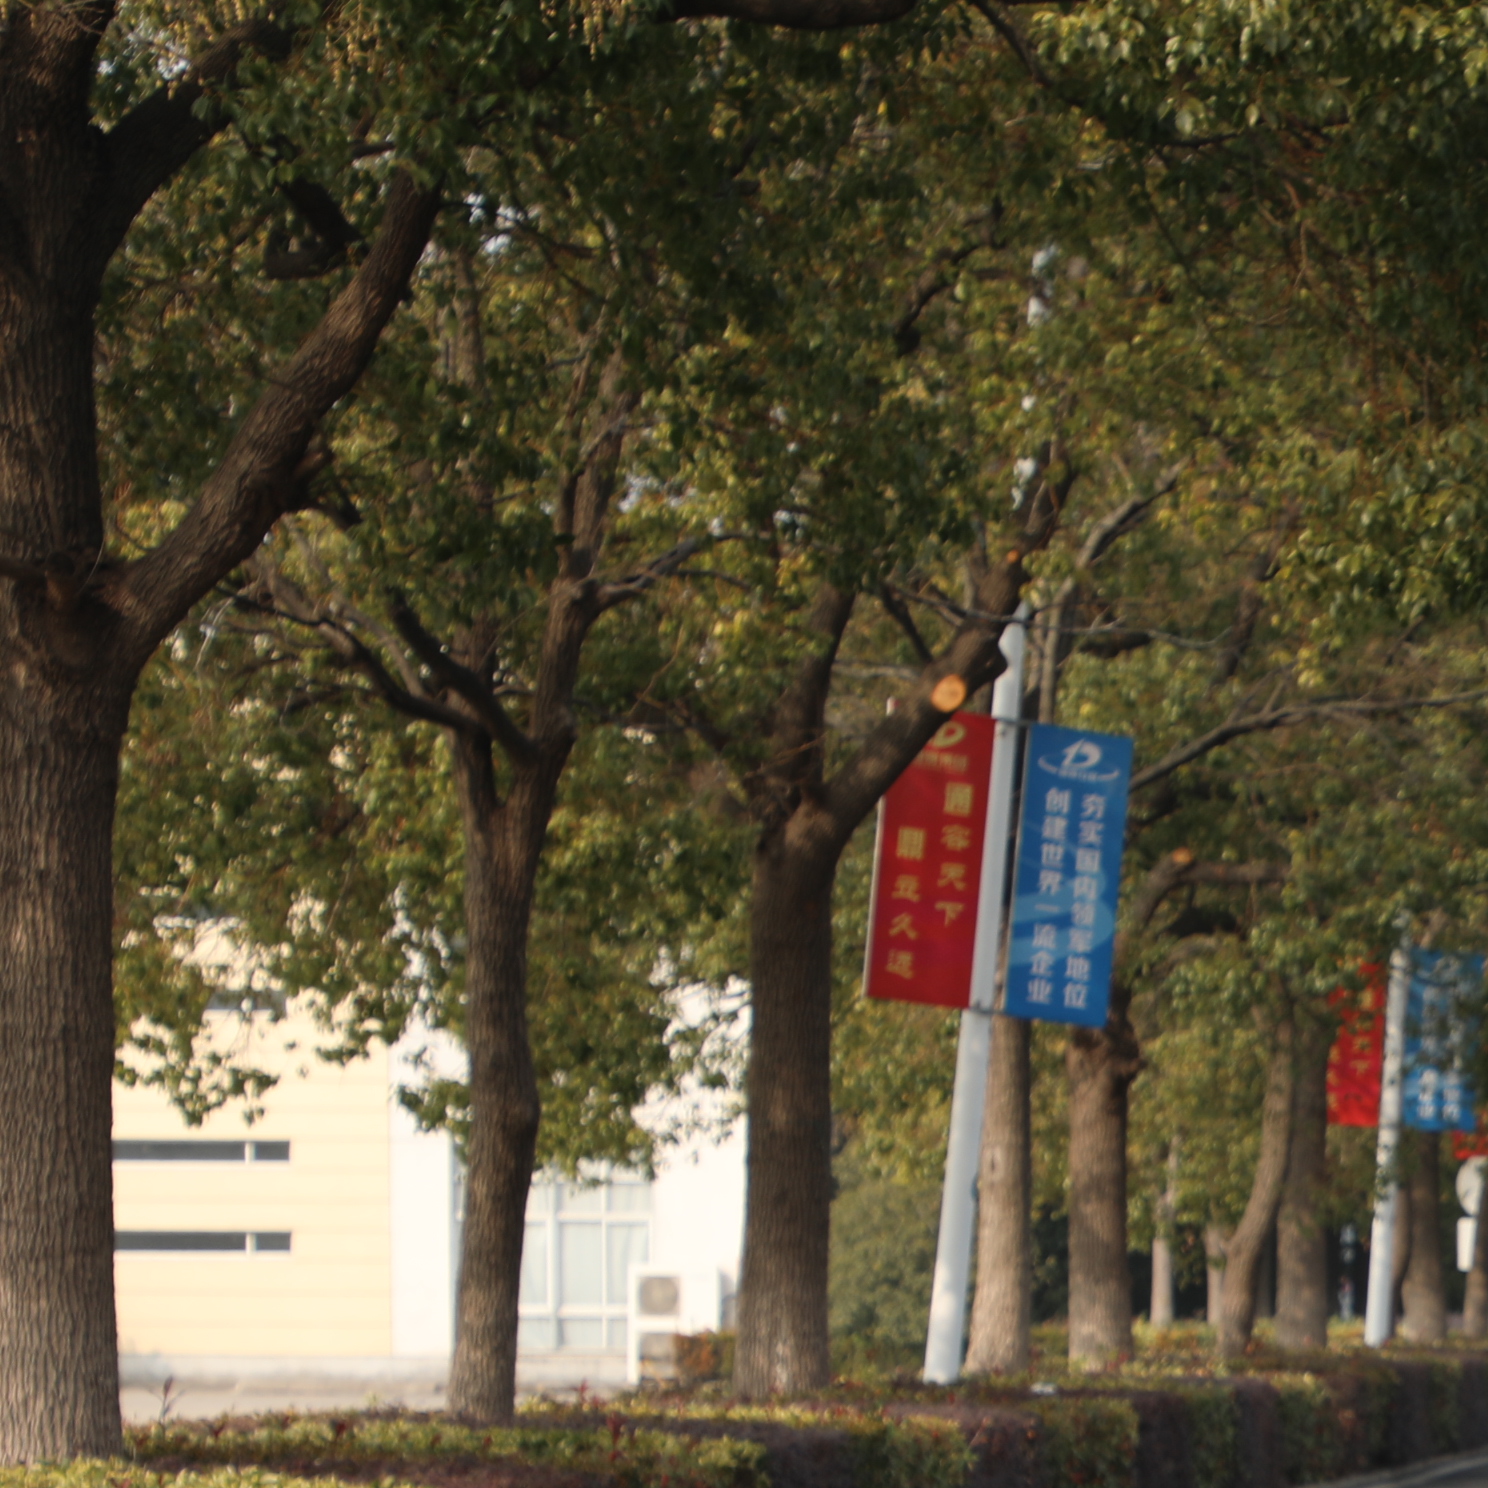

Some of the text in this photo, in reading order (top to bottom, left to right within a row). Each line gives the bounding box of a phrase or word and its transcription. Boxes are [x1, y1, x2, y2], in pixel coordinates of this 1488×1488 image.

[1026, 787, 1072, 1005] 创建世界一流企业
